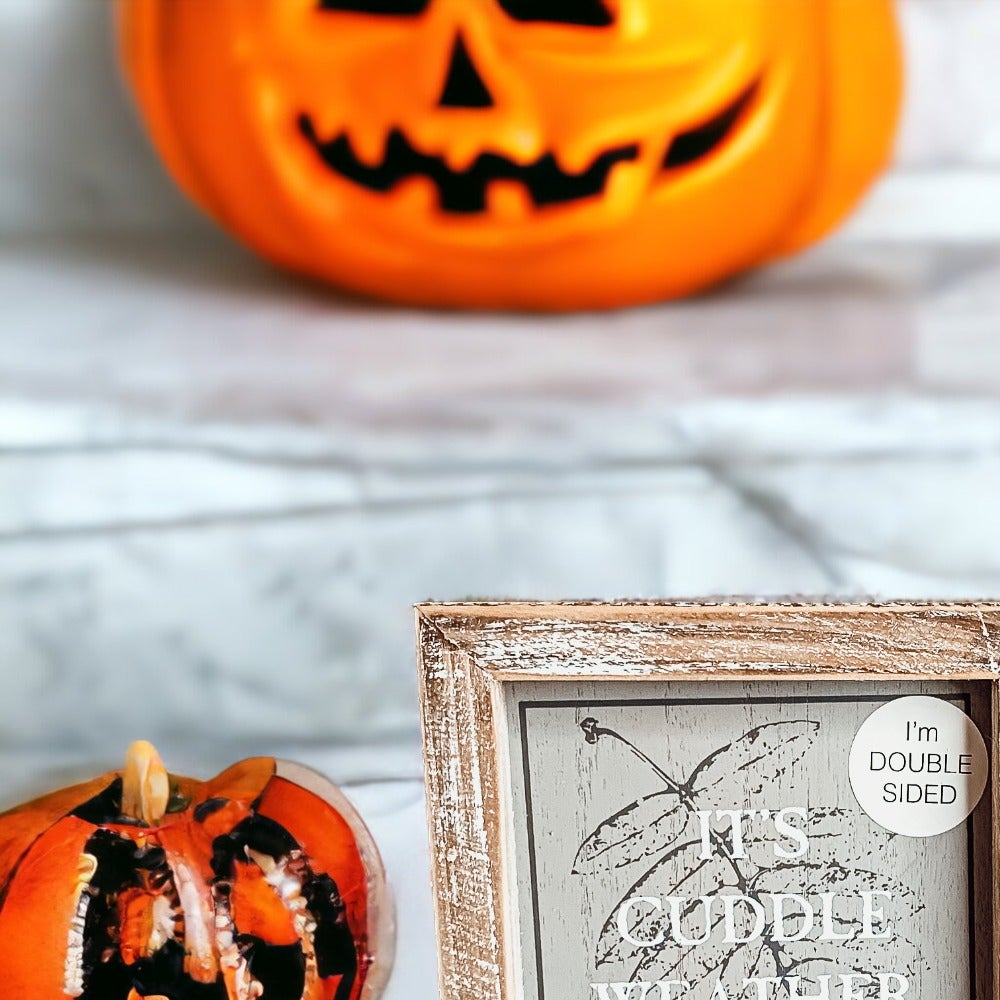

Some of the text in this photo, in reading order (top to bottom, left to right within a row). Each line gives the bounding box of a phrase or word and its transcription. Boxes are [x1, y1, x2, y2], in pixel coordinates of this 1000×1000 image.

[869, 751, 973, 775] DOUBLE
[882, 782, 957, 805] SIDED
[697, 806, 810, 861] IT'S
[618, 890, 892, 947] CUDDLE
